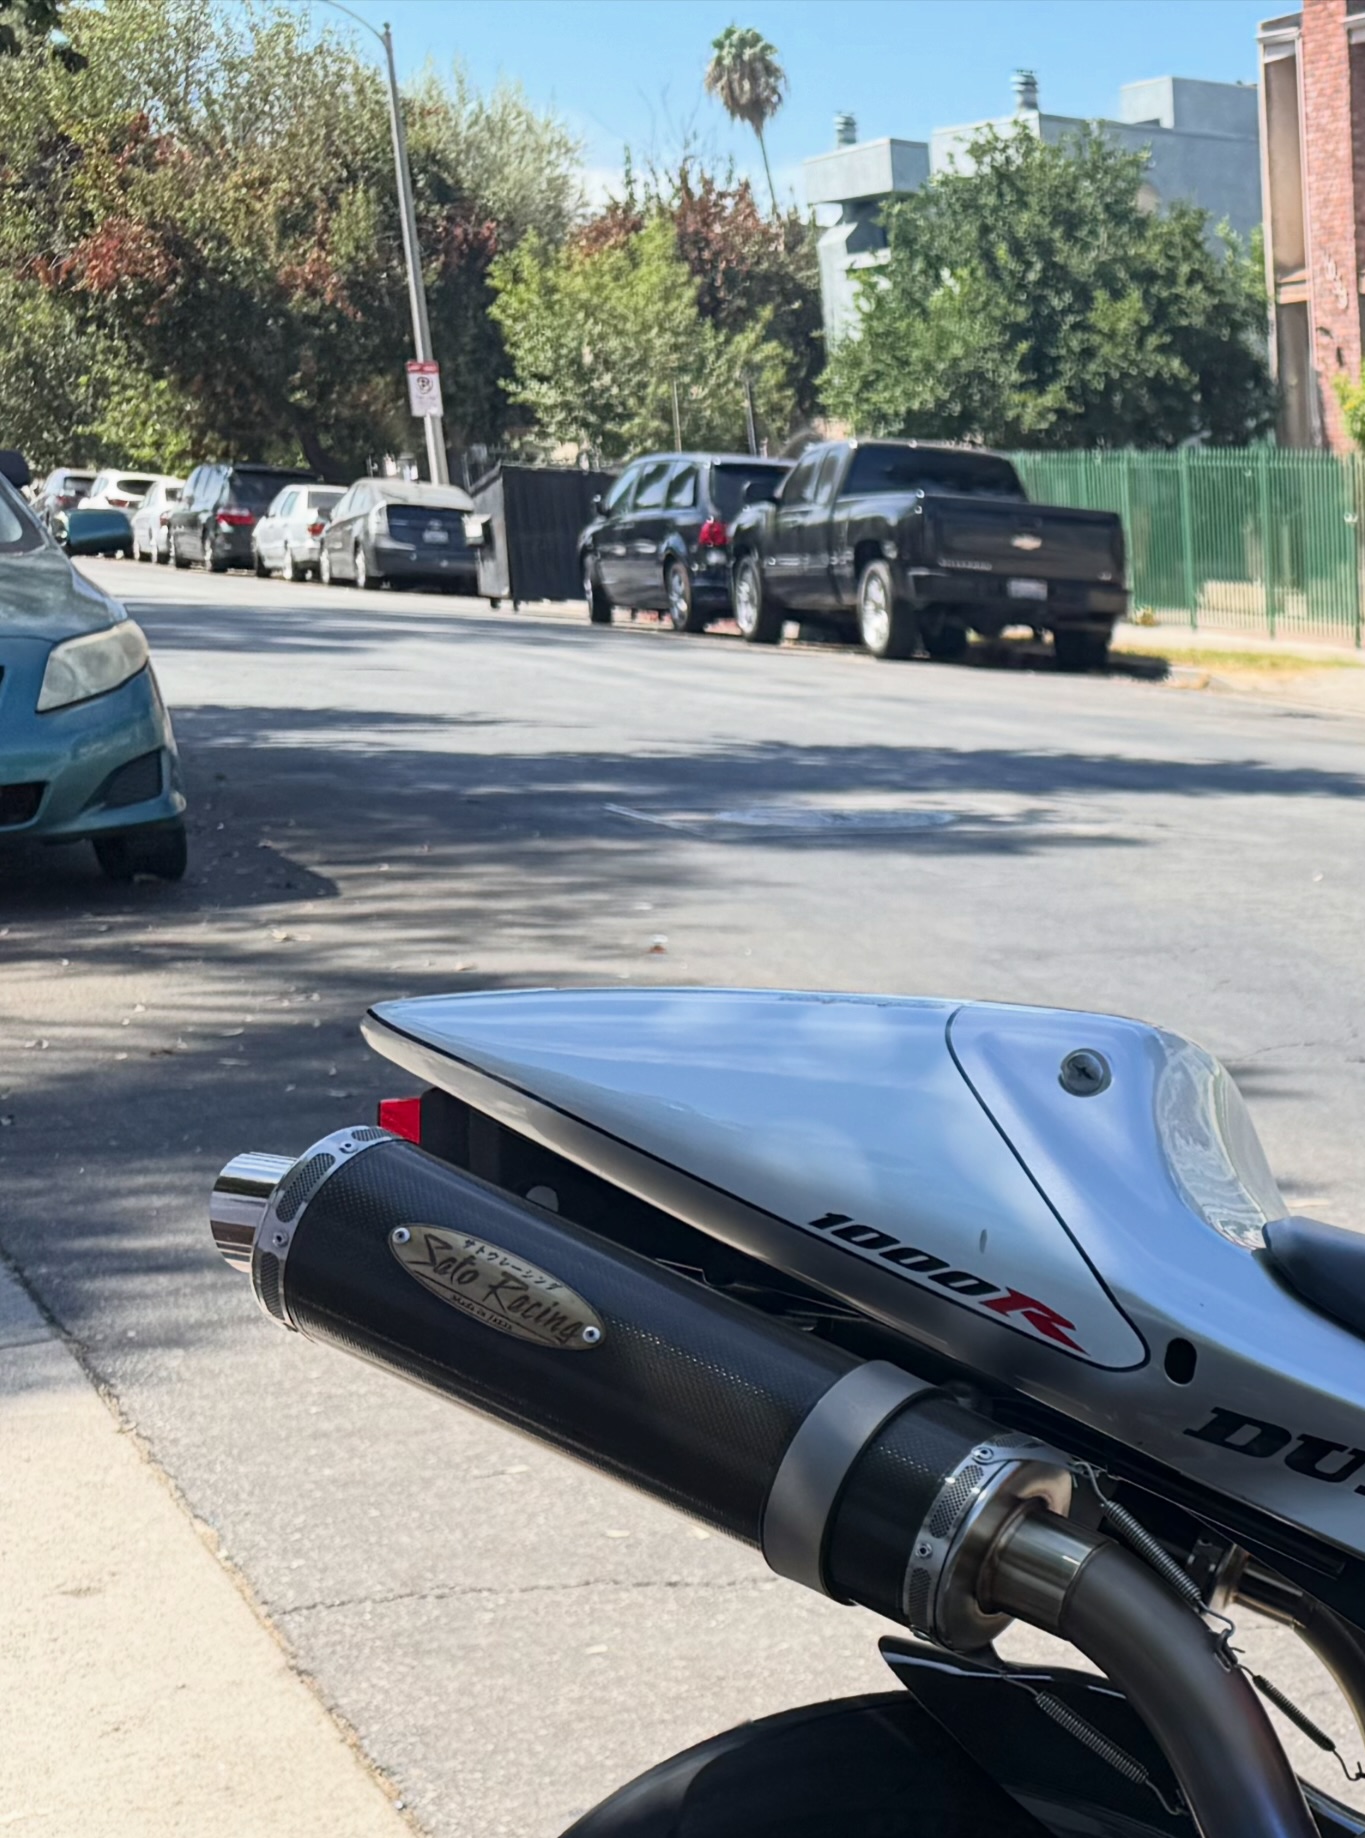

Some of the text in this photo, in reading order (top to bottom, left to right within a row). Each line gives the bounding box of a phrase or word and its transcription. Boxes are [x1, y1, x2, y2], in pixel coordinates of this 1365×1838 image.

[405, 1233, 584, 1346] Sato Racing
[808, 1212, 1091, 1356] 1000R
